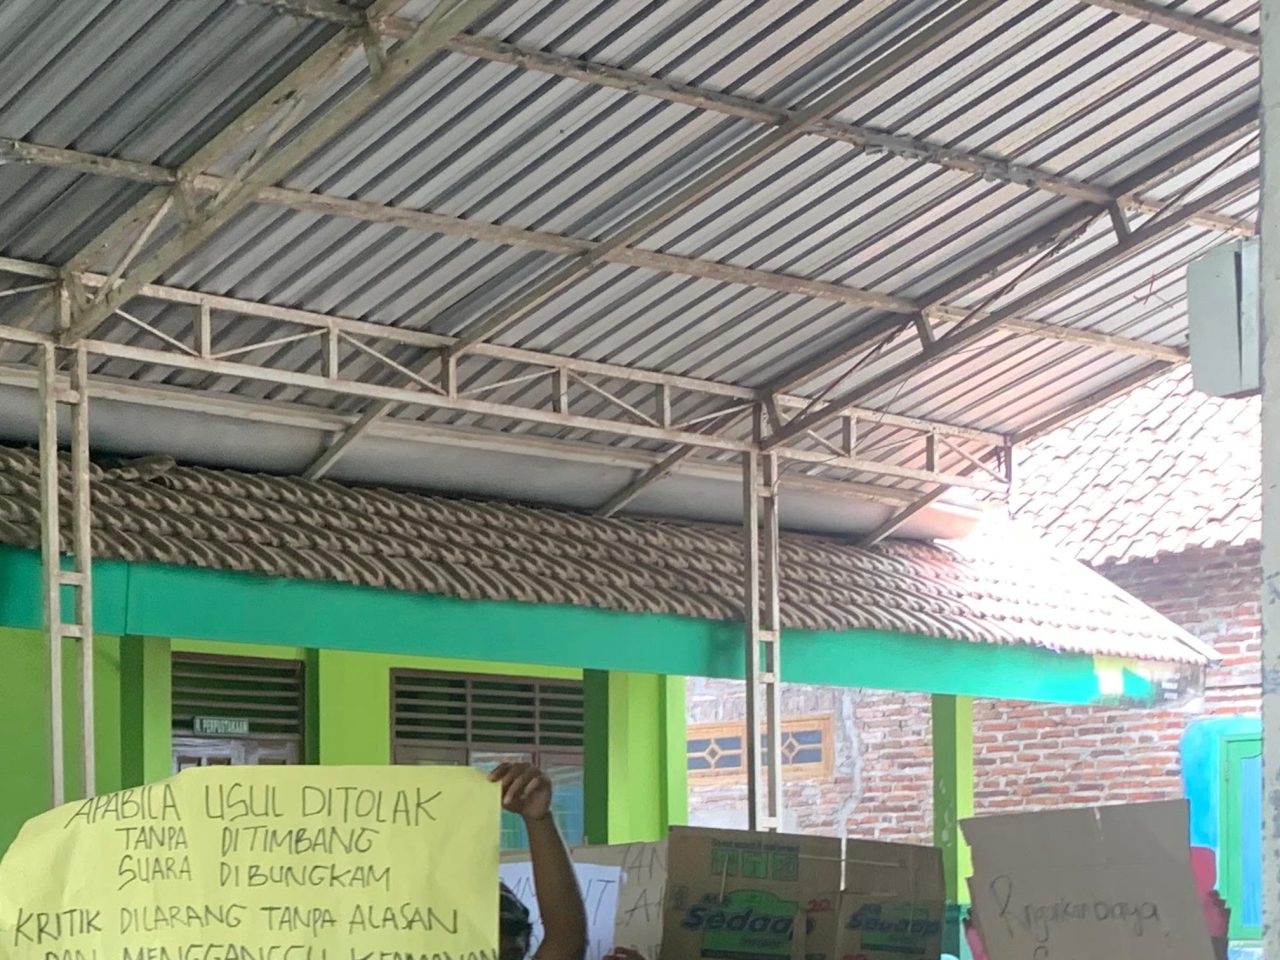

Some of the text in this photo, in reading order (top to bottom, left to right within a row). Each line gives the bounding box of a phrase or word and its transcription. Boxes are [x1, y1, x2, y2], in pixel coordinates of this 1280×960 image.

[64, 782, 443, 829] APABILA USUL DITOLAK
[115, 825, 380, 857] TANPA DITIMBANG
[118, 854, 193, 891] SUARA
[14, 902, 458, 947] KRITIK DILARANG TANPA ALASAN
